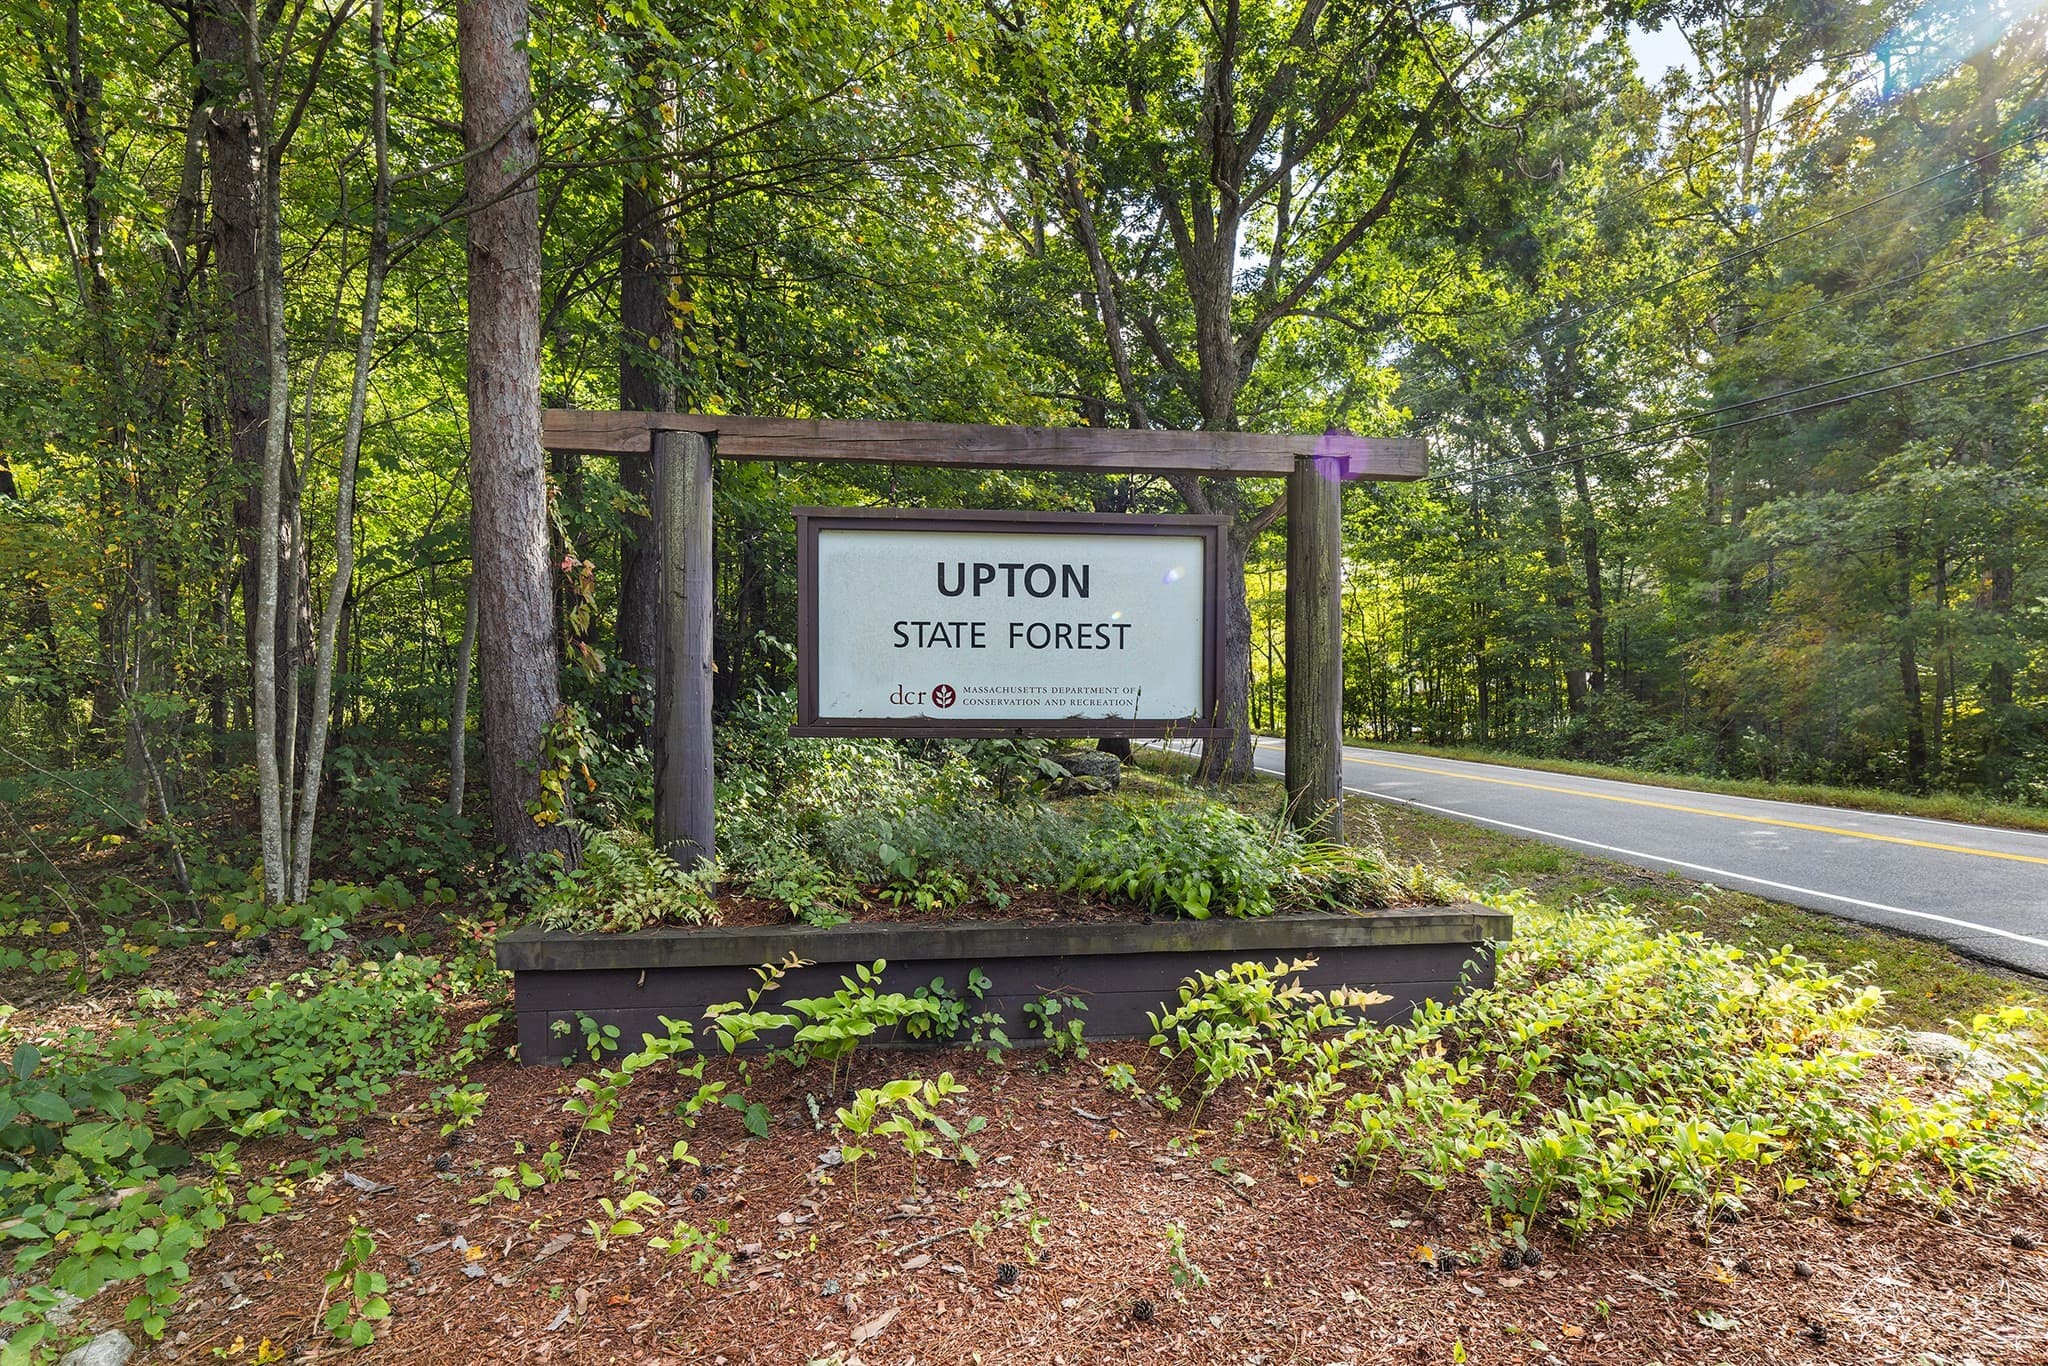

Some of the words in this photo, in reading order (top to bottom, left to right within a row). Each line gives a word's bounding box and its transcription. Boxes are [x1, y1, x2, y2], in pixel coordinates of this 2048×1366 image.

[938, 562, 1089, 598] UPTON
[894, 621, 986, 648] STATE
[1009, 623, 1131, 649] FOREST
[890, 684, 927, 705] dcr
[962, 686, 1048, 695] MASSACHUSETTS
[1051, 686, 1120, 695] DEPARTMENT
[1122, 686, 1136, 695] OF
[962, 698, 1041, 706] CONSERVATION
[1044, 698, 1067, 706] AND
[1070, 698, 1134, 706] RECREATION
